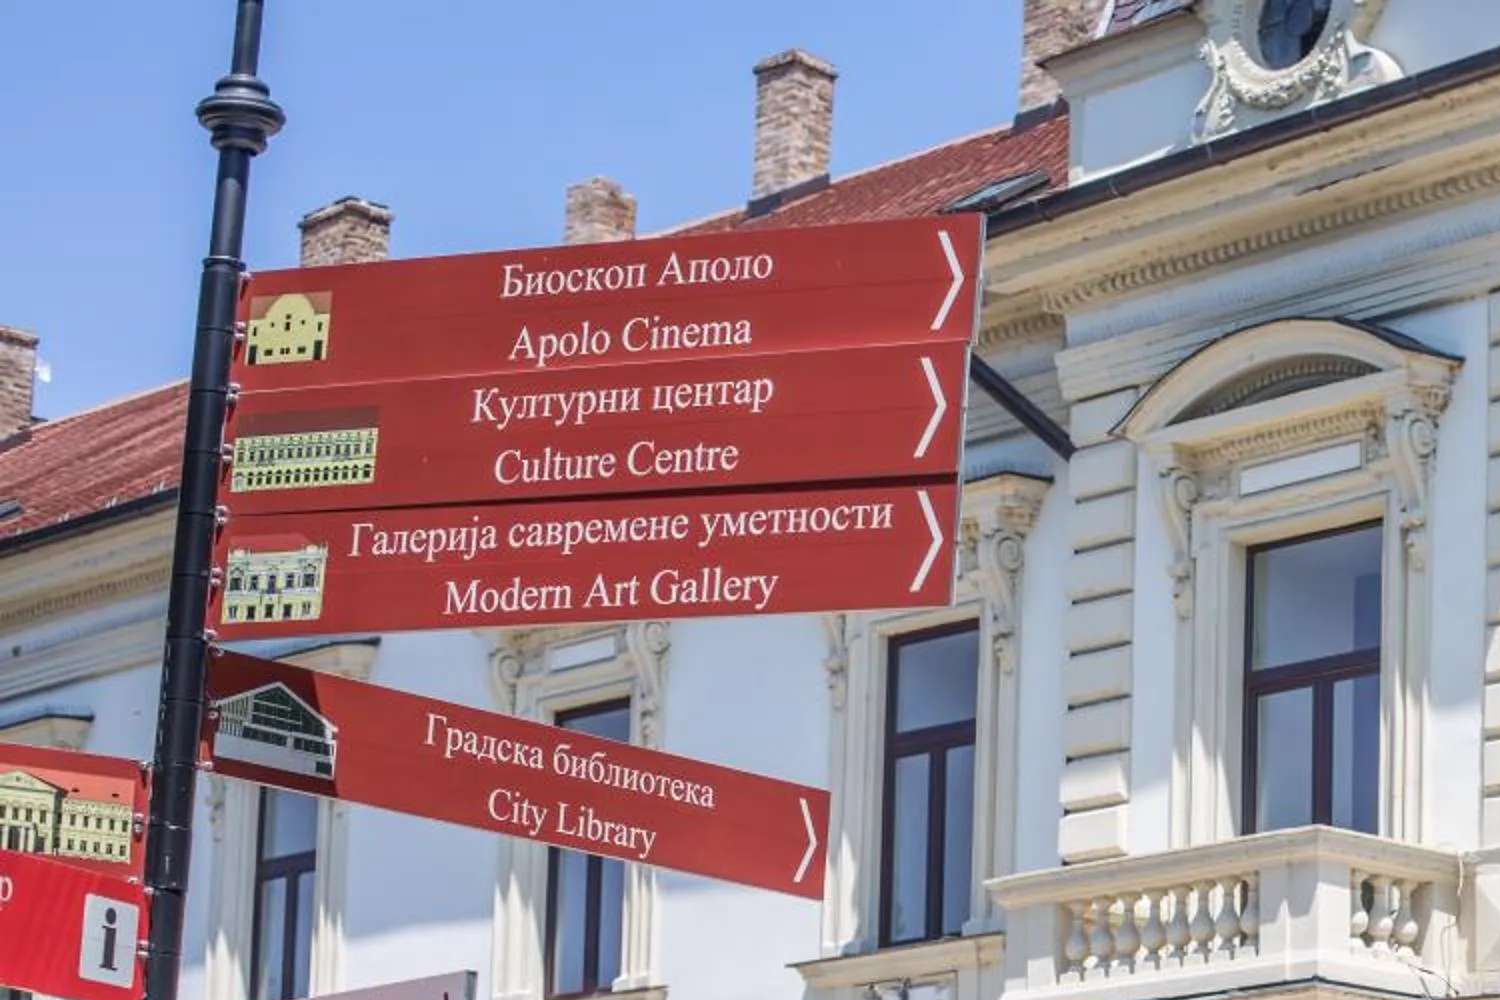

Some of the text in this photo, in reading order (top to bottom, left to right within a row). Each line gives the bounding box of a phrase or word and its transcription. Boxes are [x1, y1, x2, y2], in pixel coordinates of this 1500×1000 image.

[501, 252, 774, 297] Биоскоп Аполо
[509, 315, 753, 367] Apolo Cinema
[471, 378, 773, 429] Културни центар
[495, 441, 739, 484] Culture Centre
[347, 504, 893, 561] Галерија савремене уметности
[444, 566, 778, 614] Modern Art Gallery
[425, 714, 715, 808] Градска библиотека
[488, 788, 657, 858] City Library
